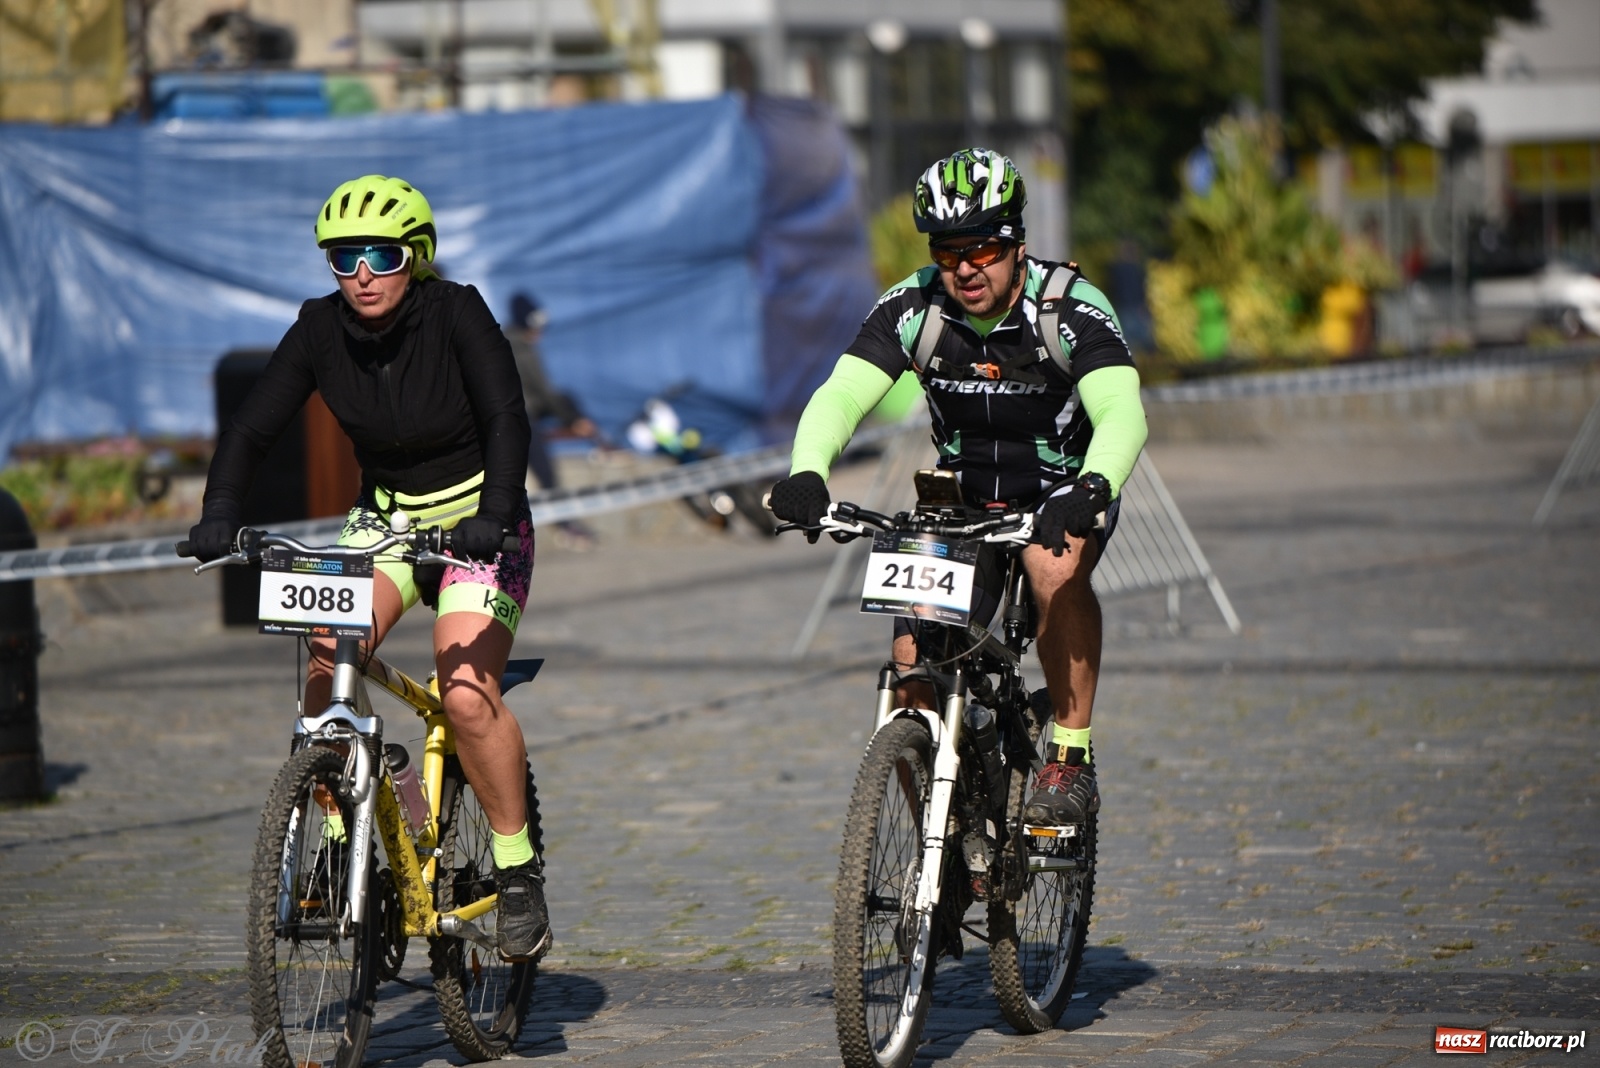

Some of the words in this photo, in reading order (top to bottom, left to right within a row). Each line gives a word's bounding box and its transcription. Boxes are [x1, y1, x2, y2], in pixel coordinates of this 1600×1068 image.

[931, 377, 1047, 395] MERIDA
[881, 563, 955, 596] 2154
[281, 584, 354, 613] 3088
